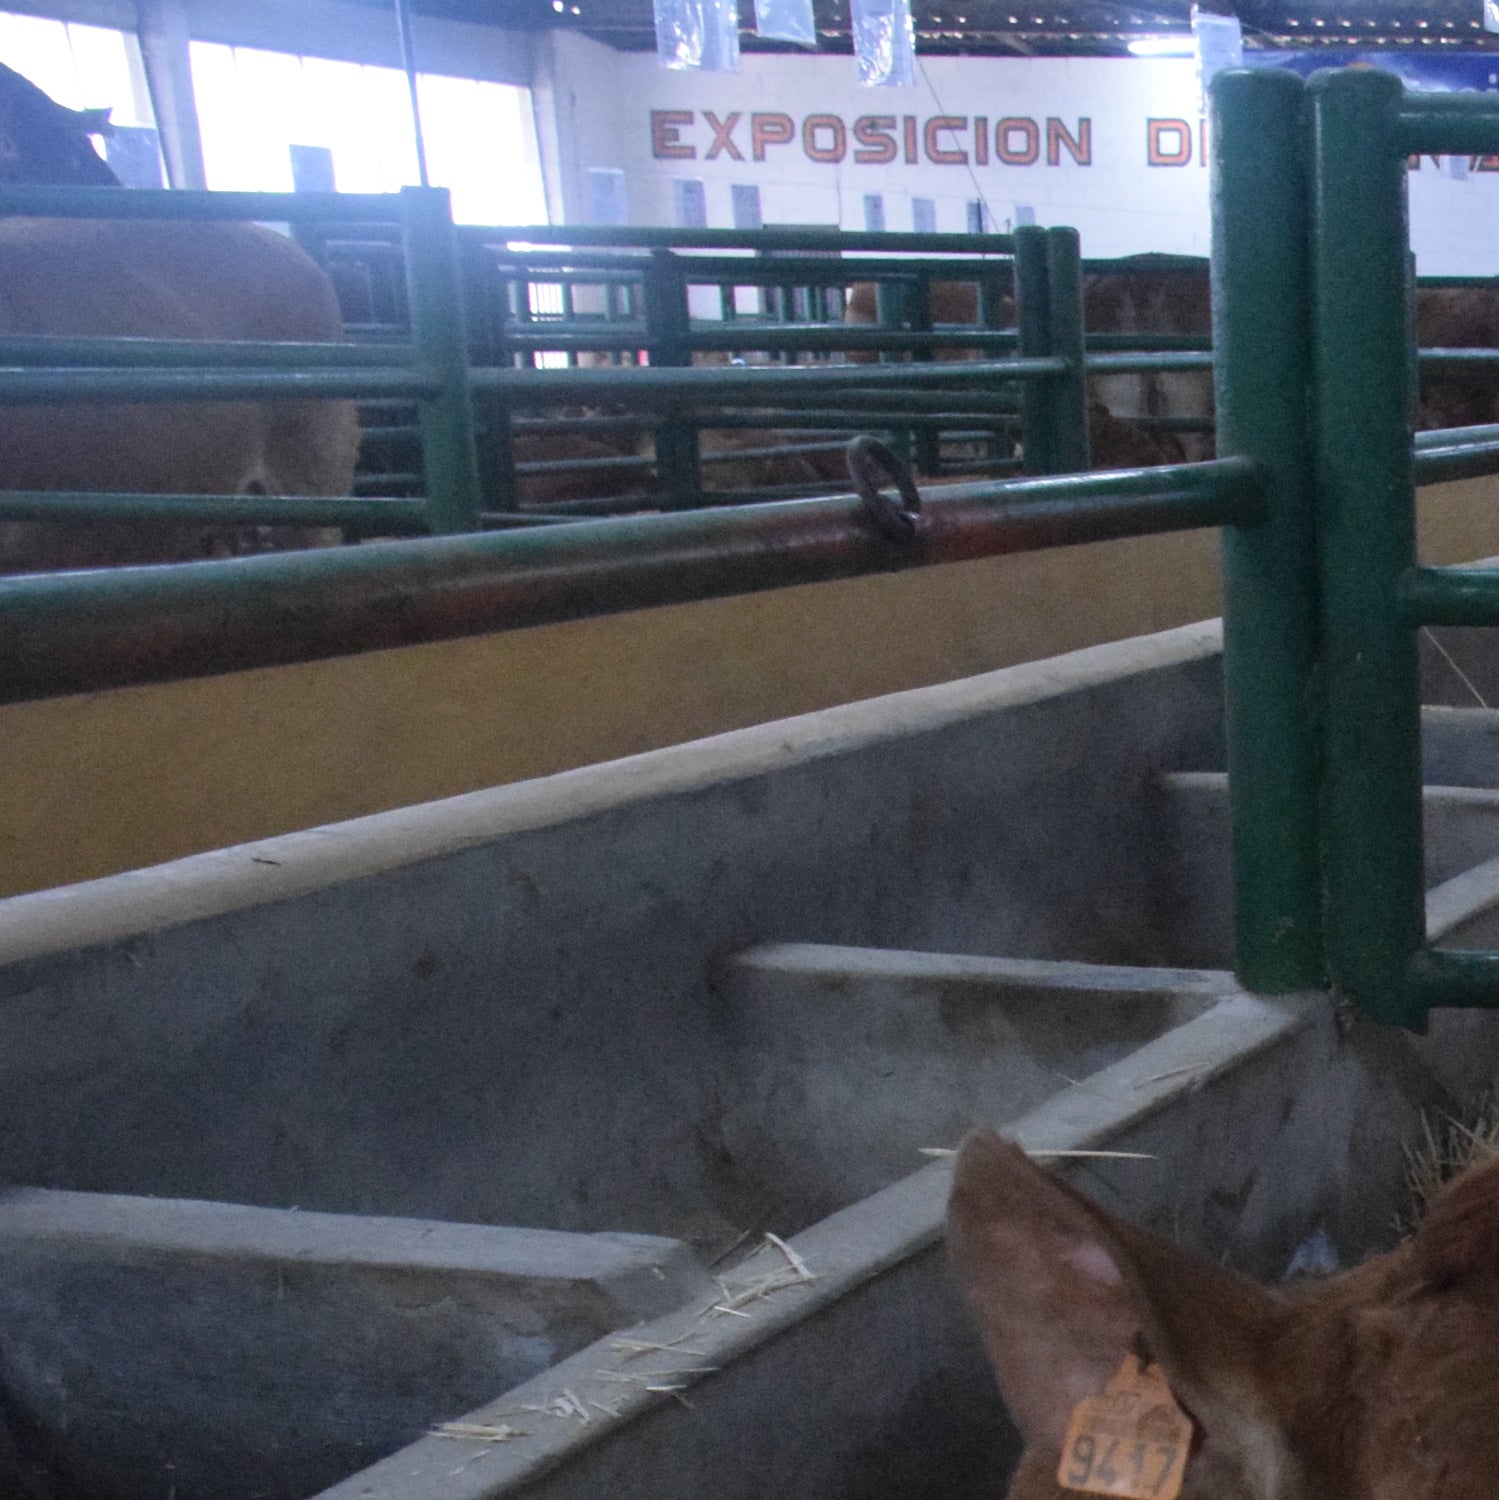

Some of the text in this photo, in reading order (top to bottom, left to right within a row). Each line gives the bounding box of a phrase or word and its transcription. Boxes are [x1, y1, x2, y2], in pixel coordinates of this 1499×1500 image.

[650, 109, 1207, 167] EXPOSICION D
[1067, 1434, 1177, 1495] 9417
